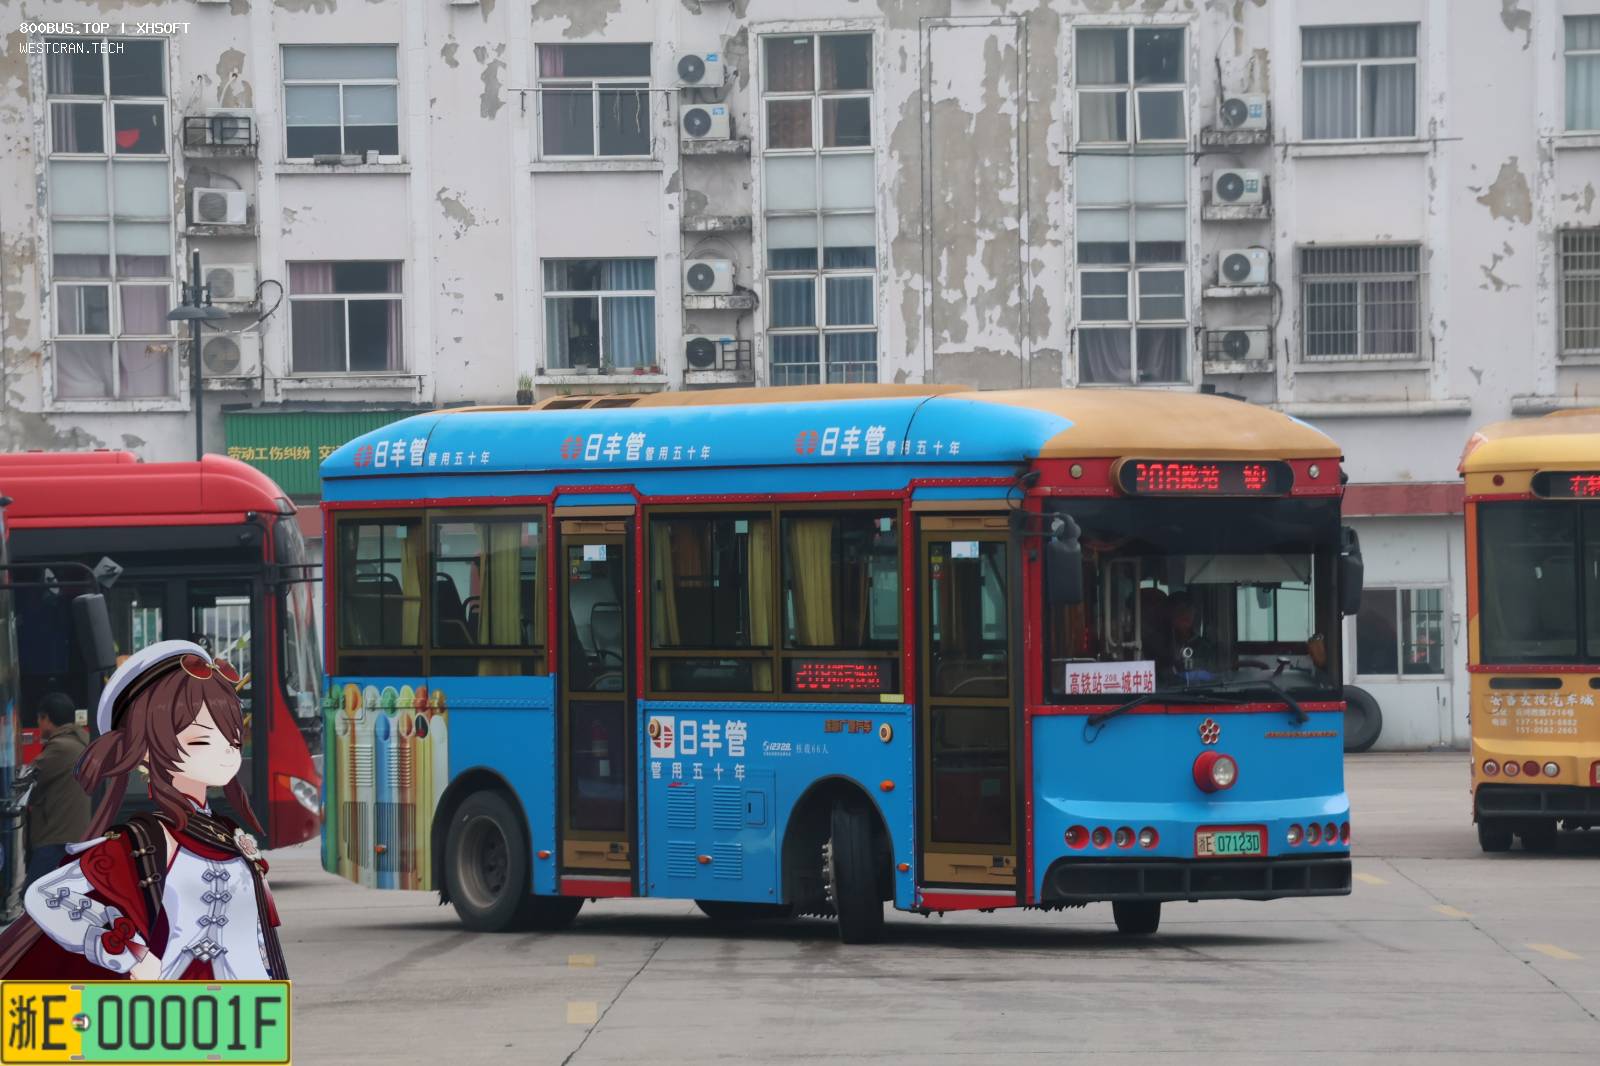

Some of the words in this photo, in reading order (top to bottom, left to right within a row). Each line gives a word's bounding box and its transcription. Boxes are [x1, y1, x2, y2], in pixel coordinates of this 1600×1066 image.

[228, 446, 311, 460] 劳动工伤纠纷
[374, 437, 426, 468] 日丰管
[428, 451, 491, 466] 管用五十年
[584, 431, 646, 462] 日丰管
[646, 445, 711, 461] 管用五十年
[820, 425, 887, 456] 日丰管
[886, 440, 961, 456] 管用五十年
[1070, 671, 1102, 694] 高铁站
[1122, 670, 1153, 694] 城中站
[679, 719, 748, 758] 日丰管
[651, 761, 746, 782] 管用五十年
[1217, 834, 1260, 852] 07123D
